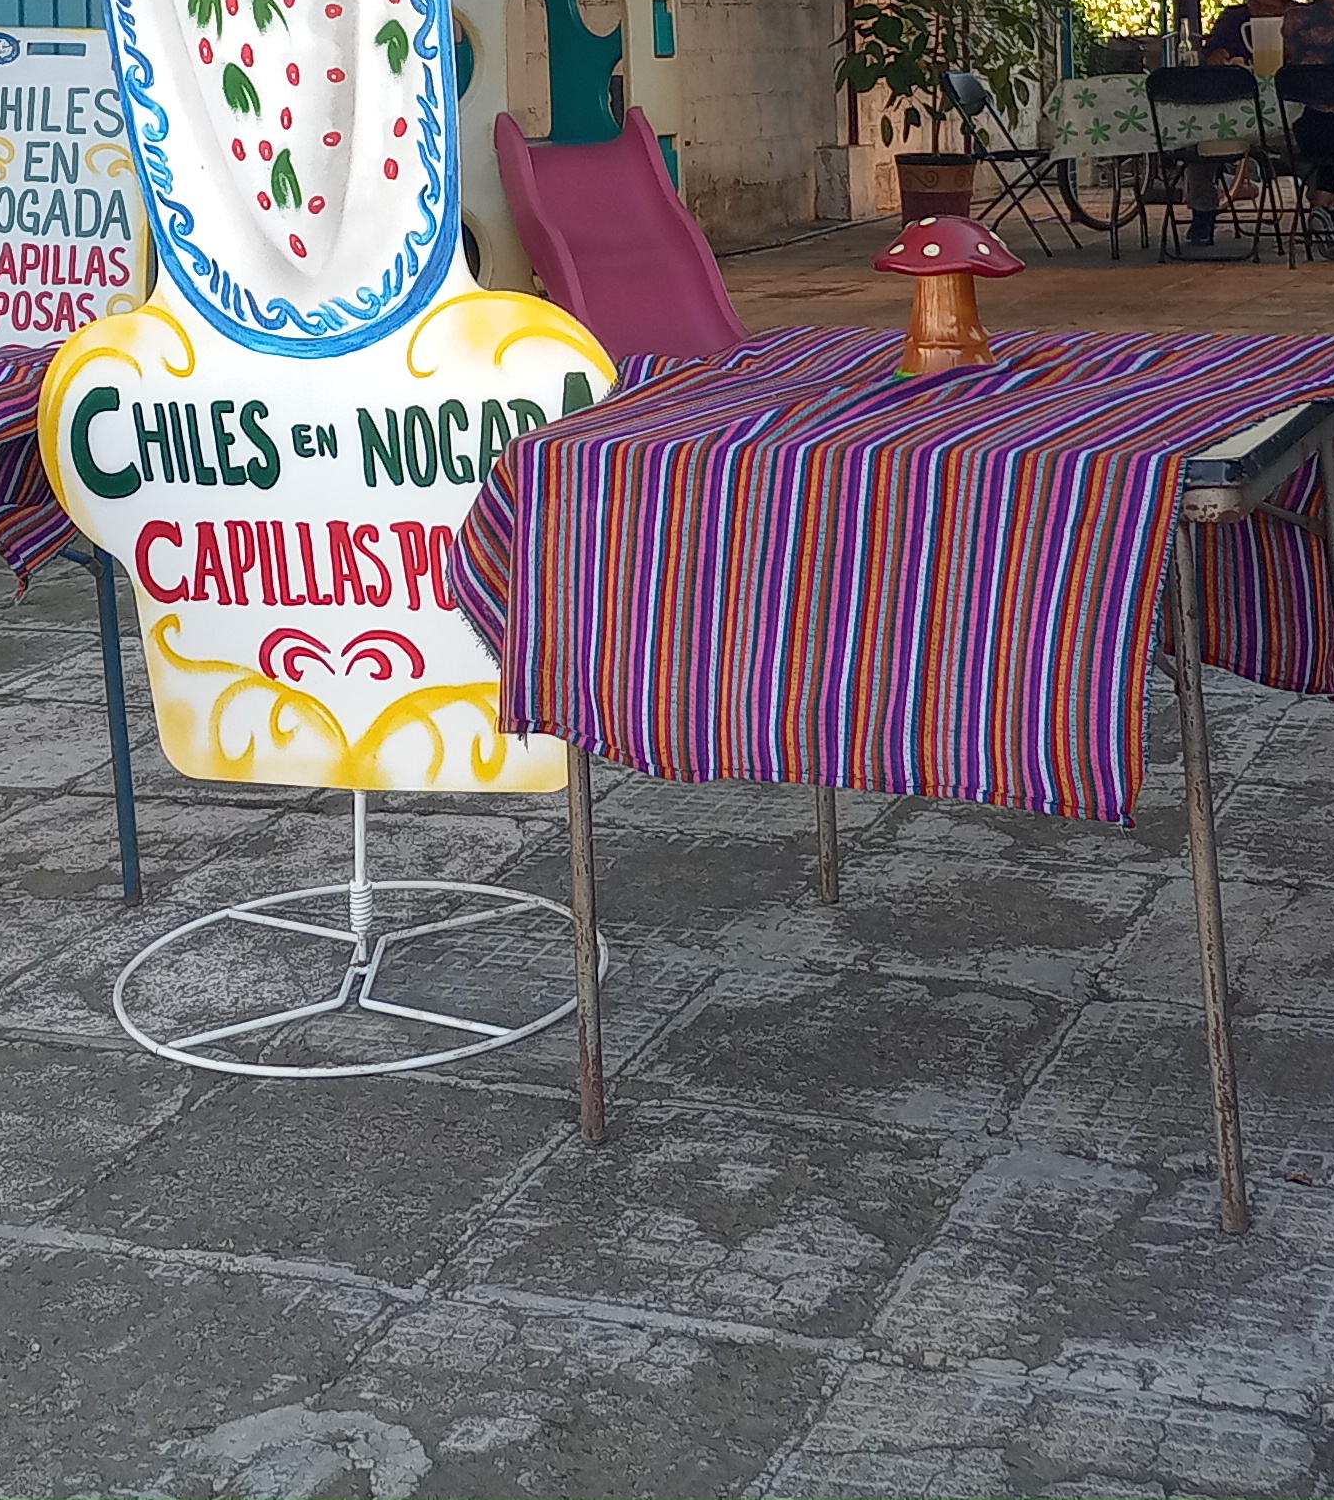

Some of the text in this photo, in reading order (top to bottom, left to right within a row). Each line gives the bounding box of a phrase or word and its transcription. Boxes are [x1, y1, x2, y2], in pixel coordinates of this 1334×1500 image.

[24, 141, 79, 184] EN
[70, 386, 281, 499] CHILES
[291, 423, 337, 459] EN
[134, 519, 393, 607] CAPILLAS
